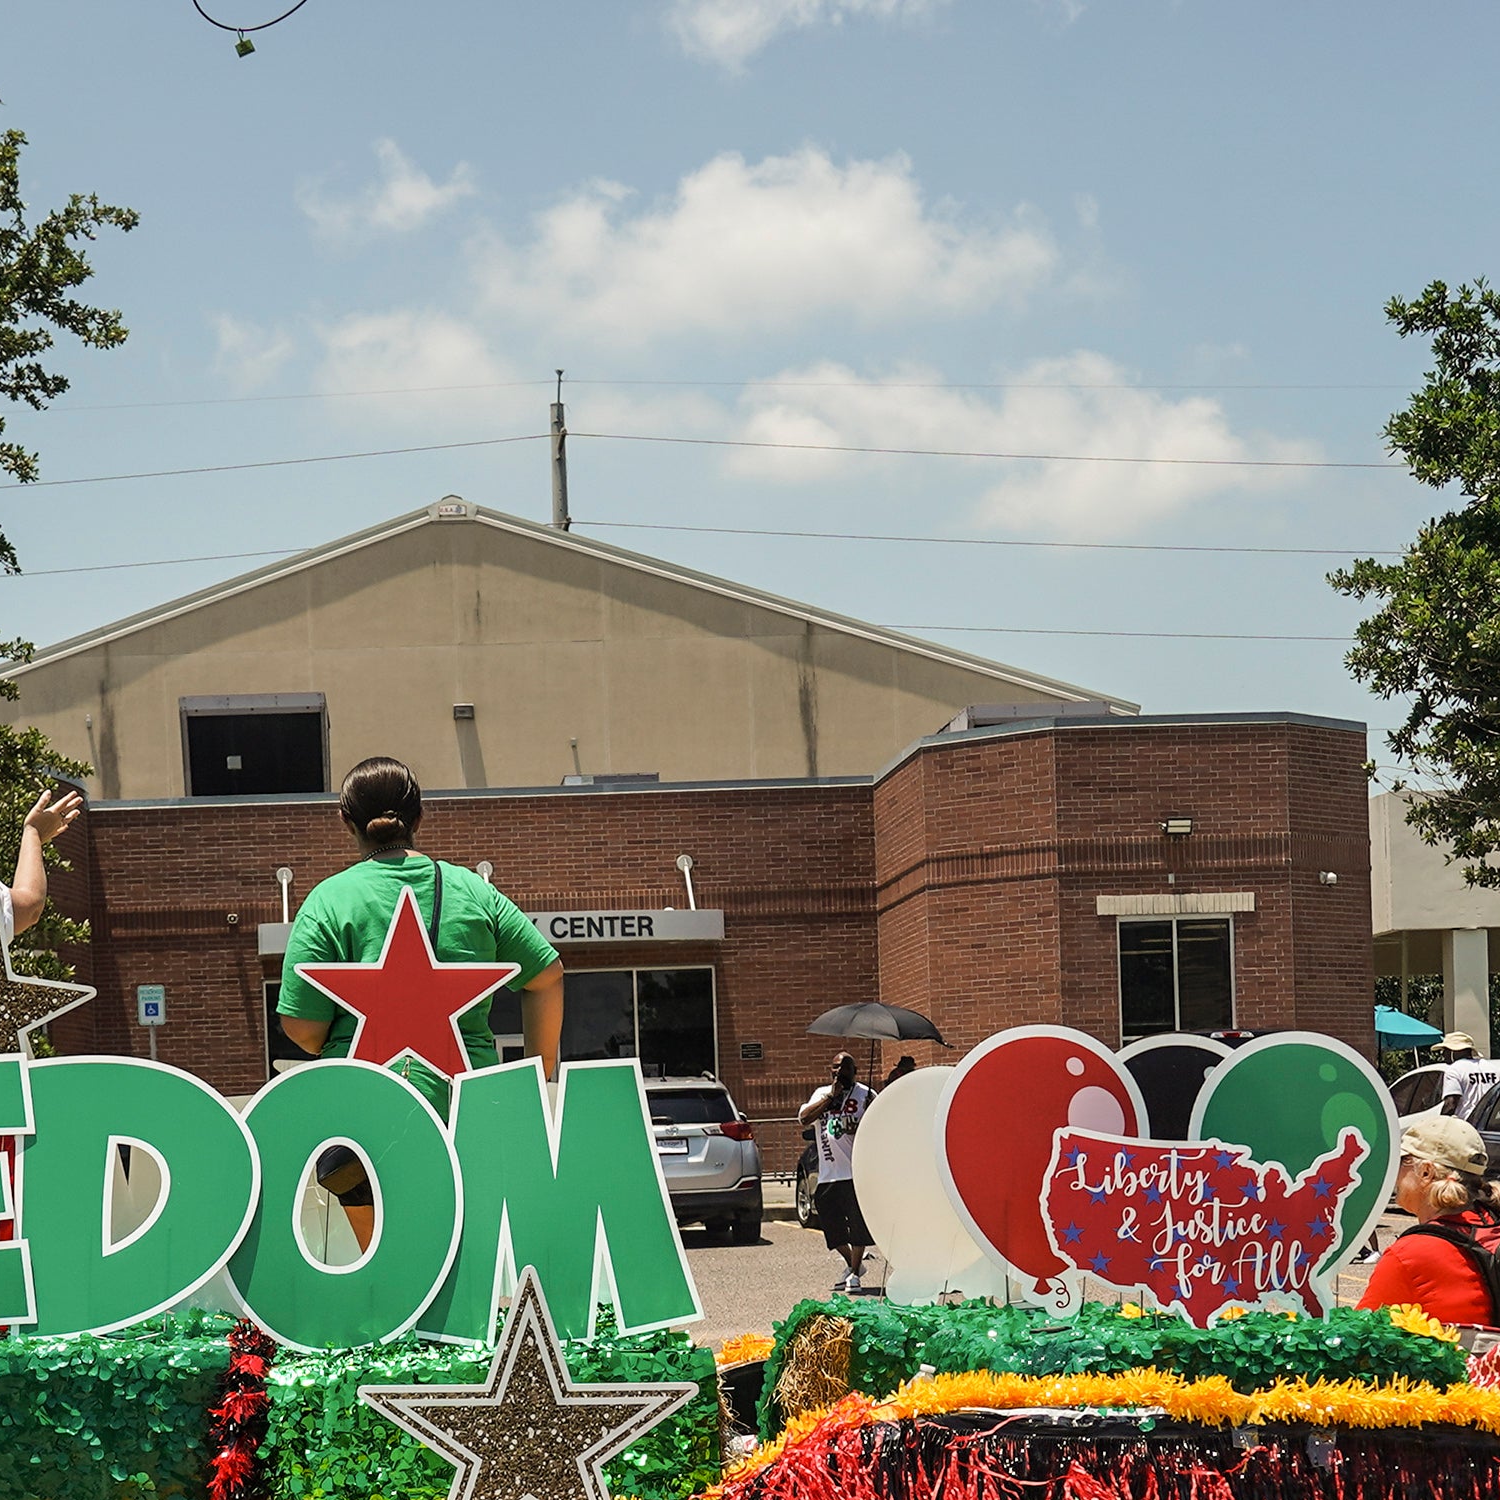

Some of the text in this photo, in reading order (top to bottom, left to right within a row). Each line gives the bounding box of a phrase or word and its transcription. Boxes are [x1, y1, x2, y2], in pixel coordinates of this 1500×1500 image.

[550, 915, 654, 939] CENTER
[1469, 1072, 1497, 1085] STAFF
[1056, 1148, 1210, 1206] Liberty
[1116, 1196, 1268, 1256] & Justice
[1150, 1240, 1312, 1300] for All
